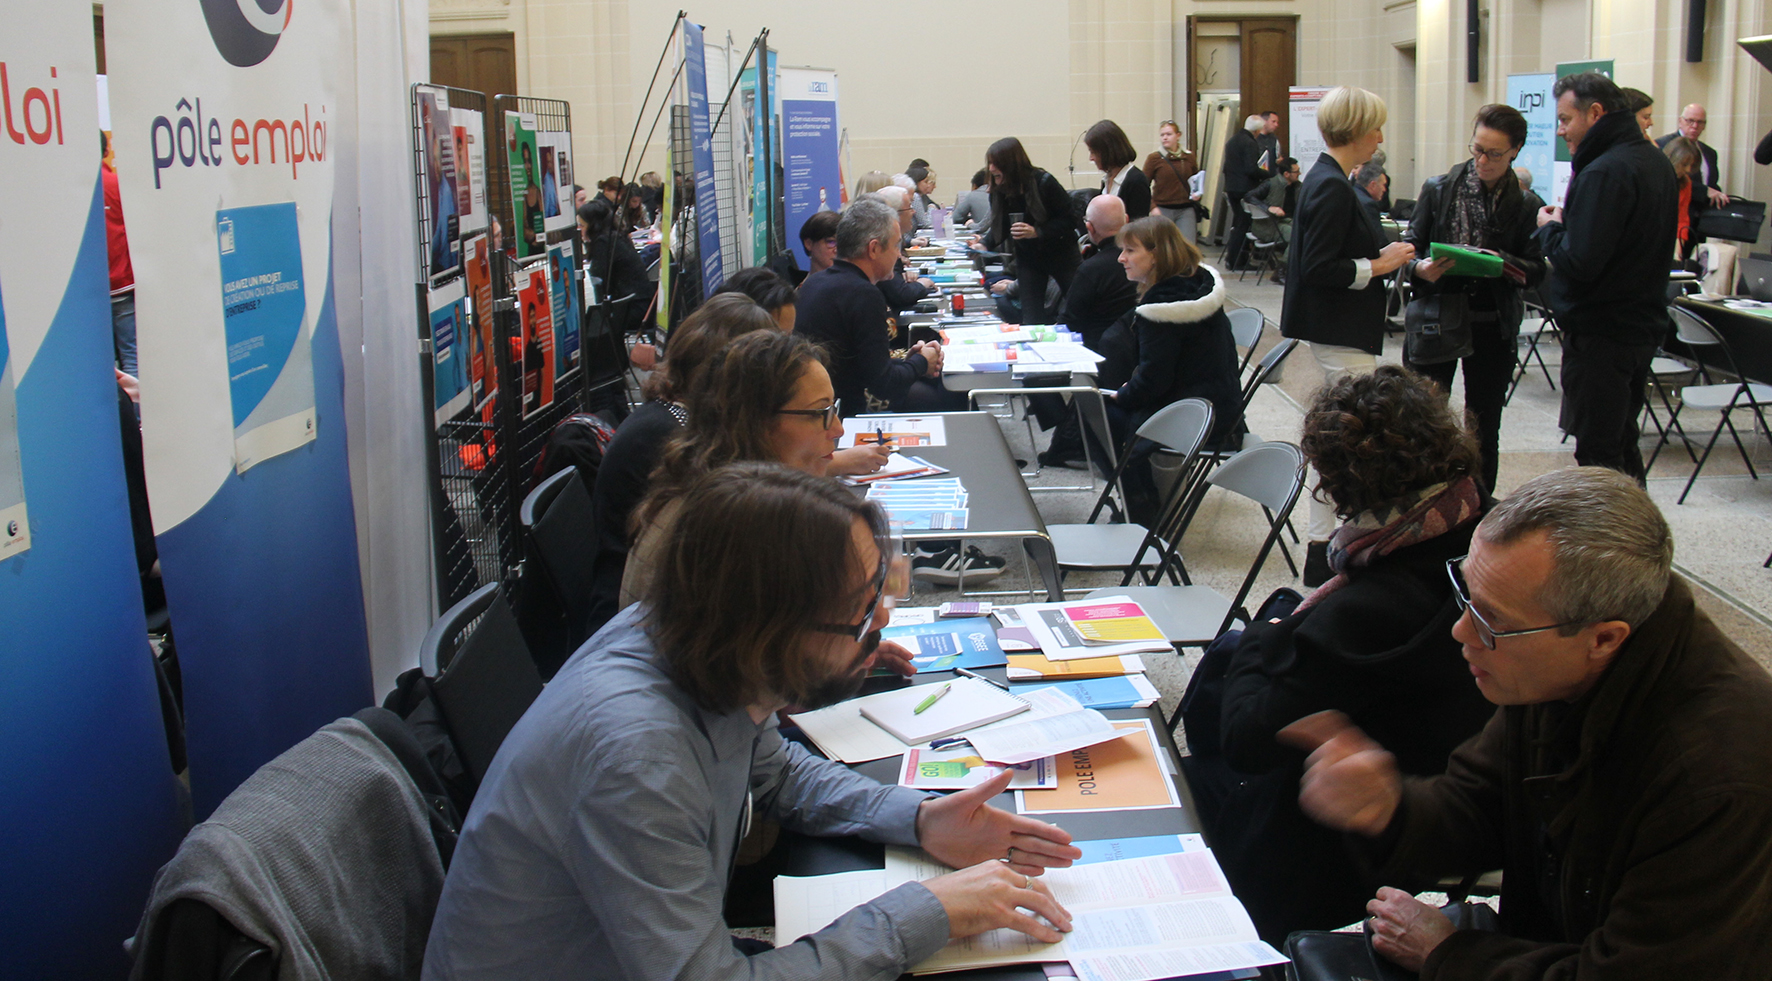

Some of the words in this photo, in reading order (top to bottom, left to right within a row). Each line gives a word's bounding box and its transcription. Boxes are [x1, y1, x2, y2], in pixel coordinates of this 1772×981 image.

[0, 62, 63, 145] loi
[1519, 90, 1545, 113] inpi
[151, 97, 222, 190] pôle
[231, 103, 326, 180] emploi
[235, 278, 248, 289] AVEZ
[248, 276, 259, 287] UN
[259, 271, 282, 284] PROJET
[255, 286, 265, 297] OU
[266, 284, 275, 295] DE
[275, 280, 299, 293] REPRISE
[1071, 748, 1092, 769] EMP
[921, 764, 940, 778] GO!
[1076, 771, 1098, 796] POLE
